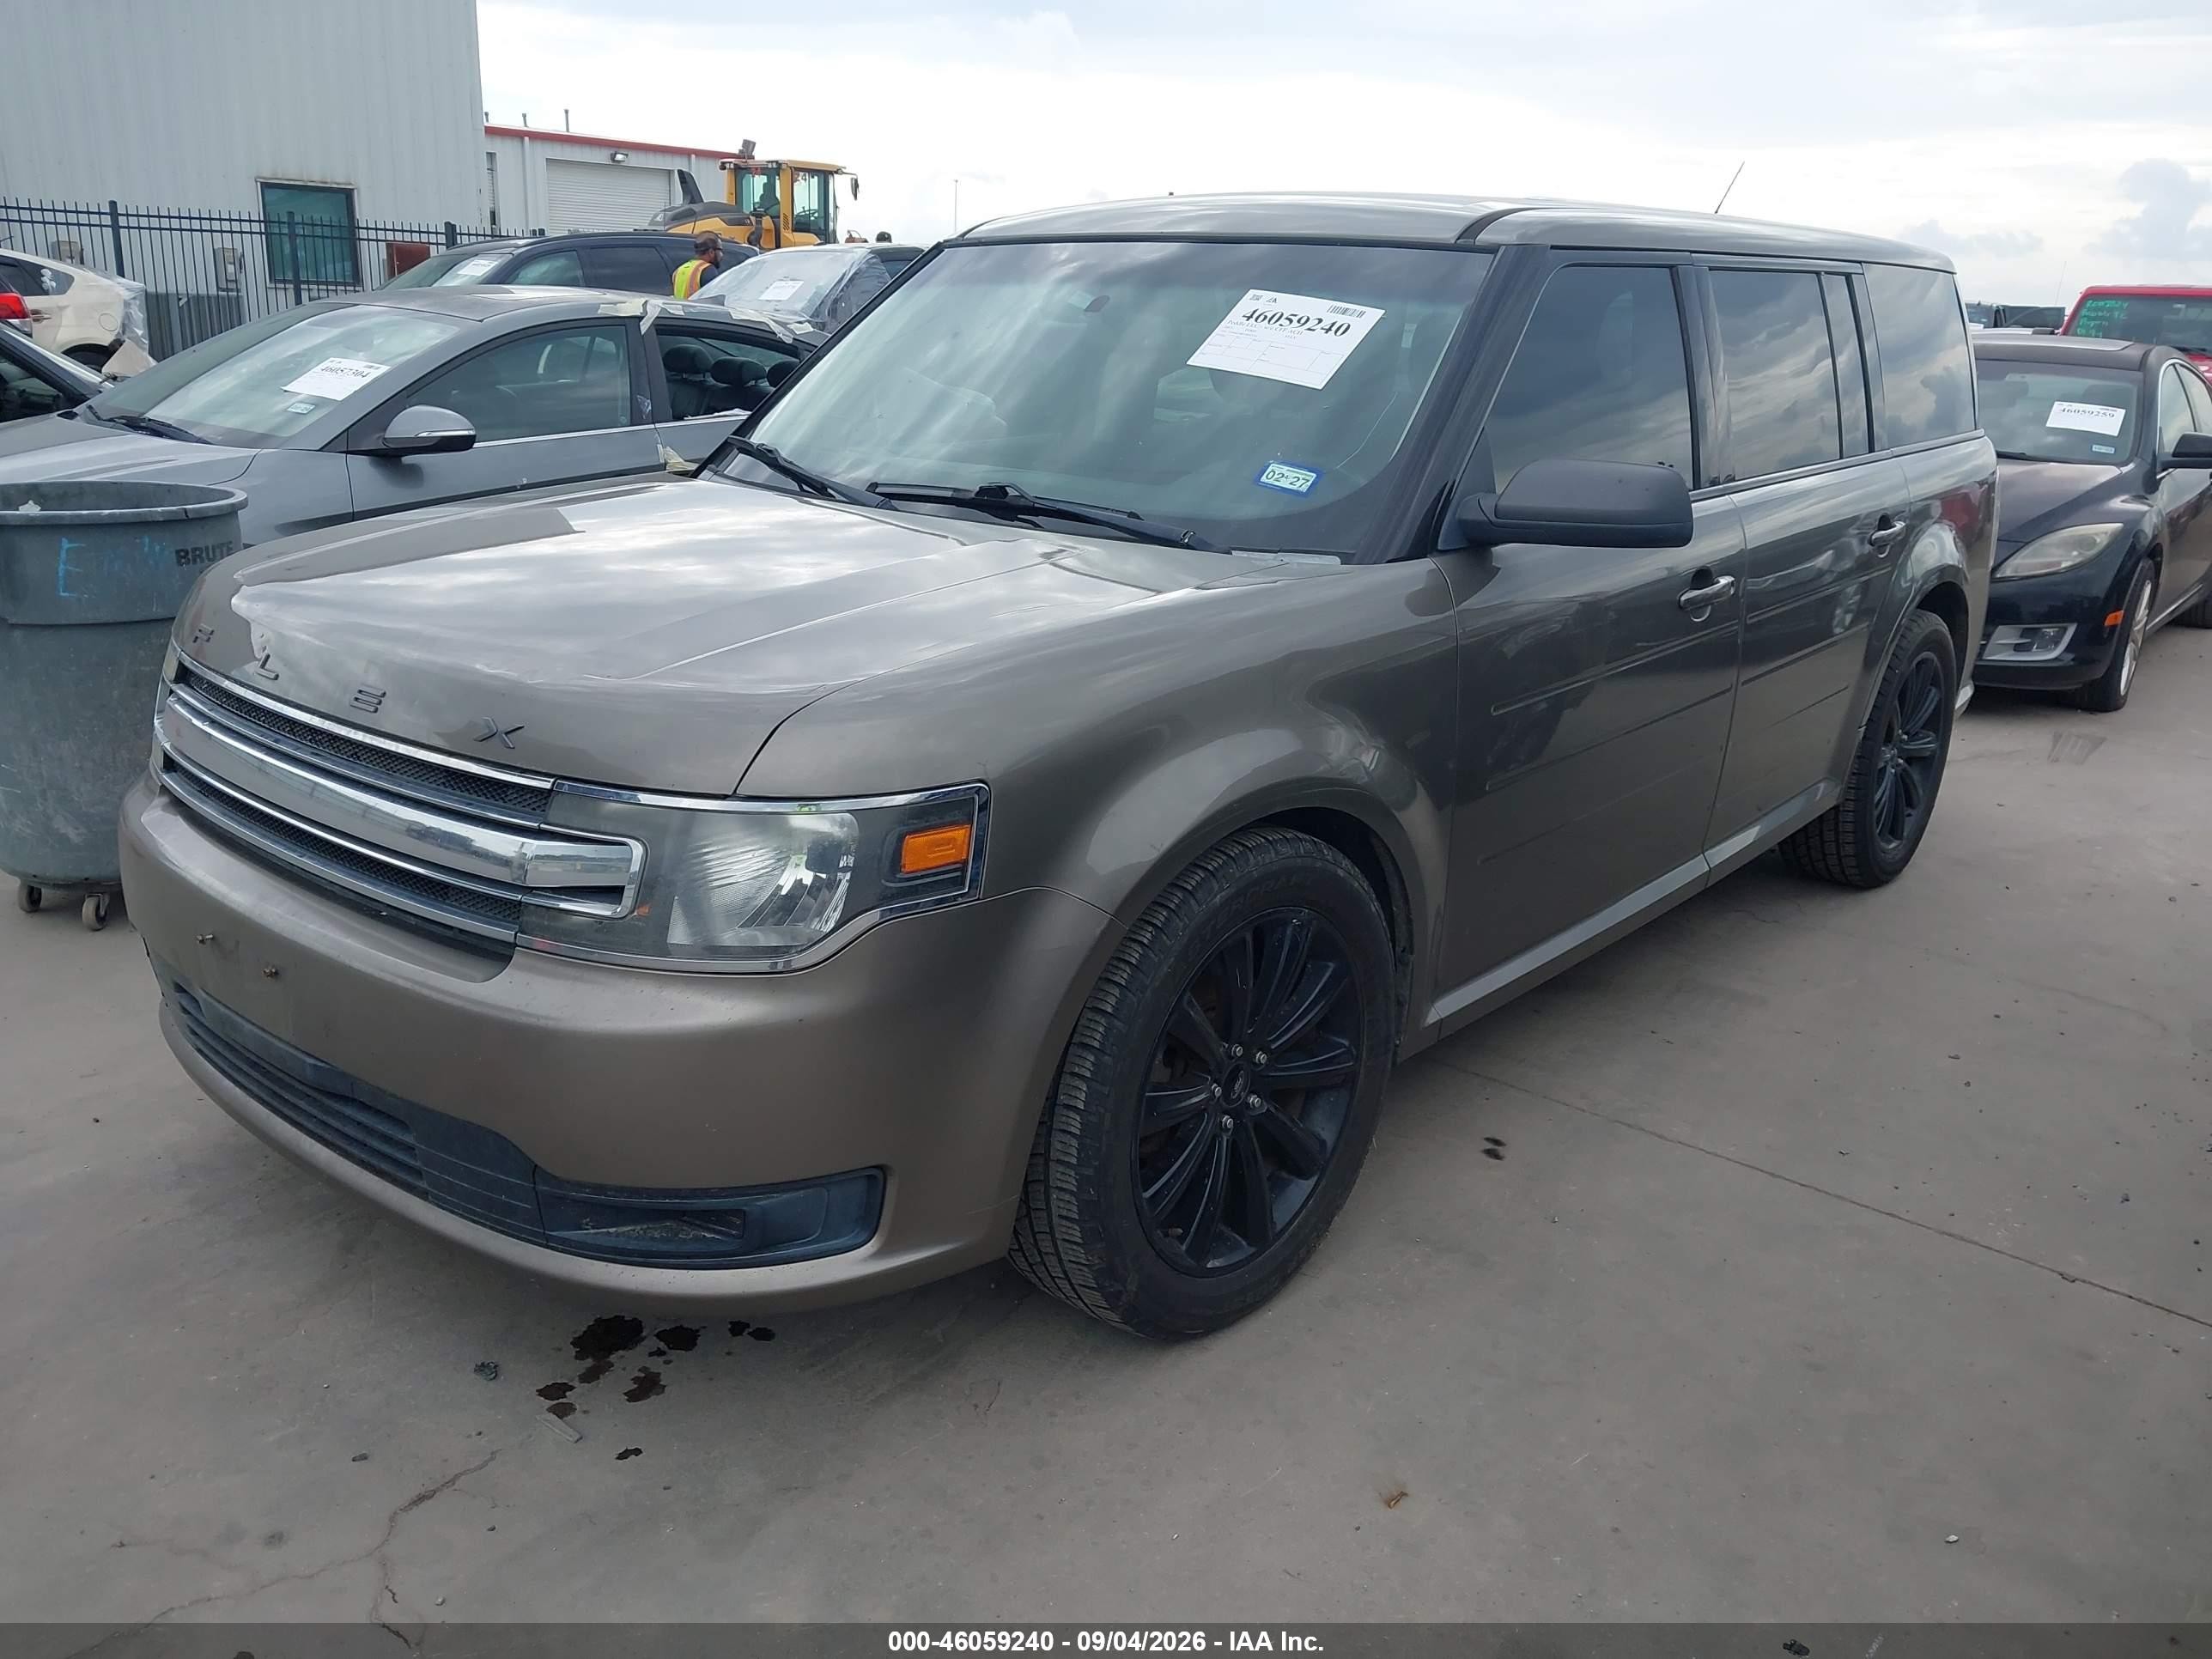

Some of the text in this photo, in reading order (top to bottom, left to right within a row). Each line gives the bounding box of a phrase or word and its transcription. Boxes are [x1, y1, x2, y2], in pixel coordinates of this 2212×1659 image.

[1242, 307, 1351, 337] 46059240
[1266, 470, 1310, 488] 02 27
